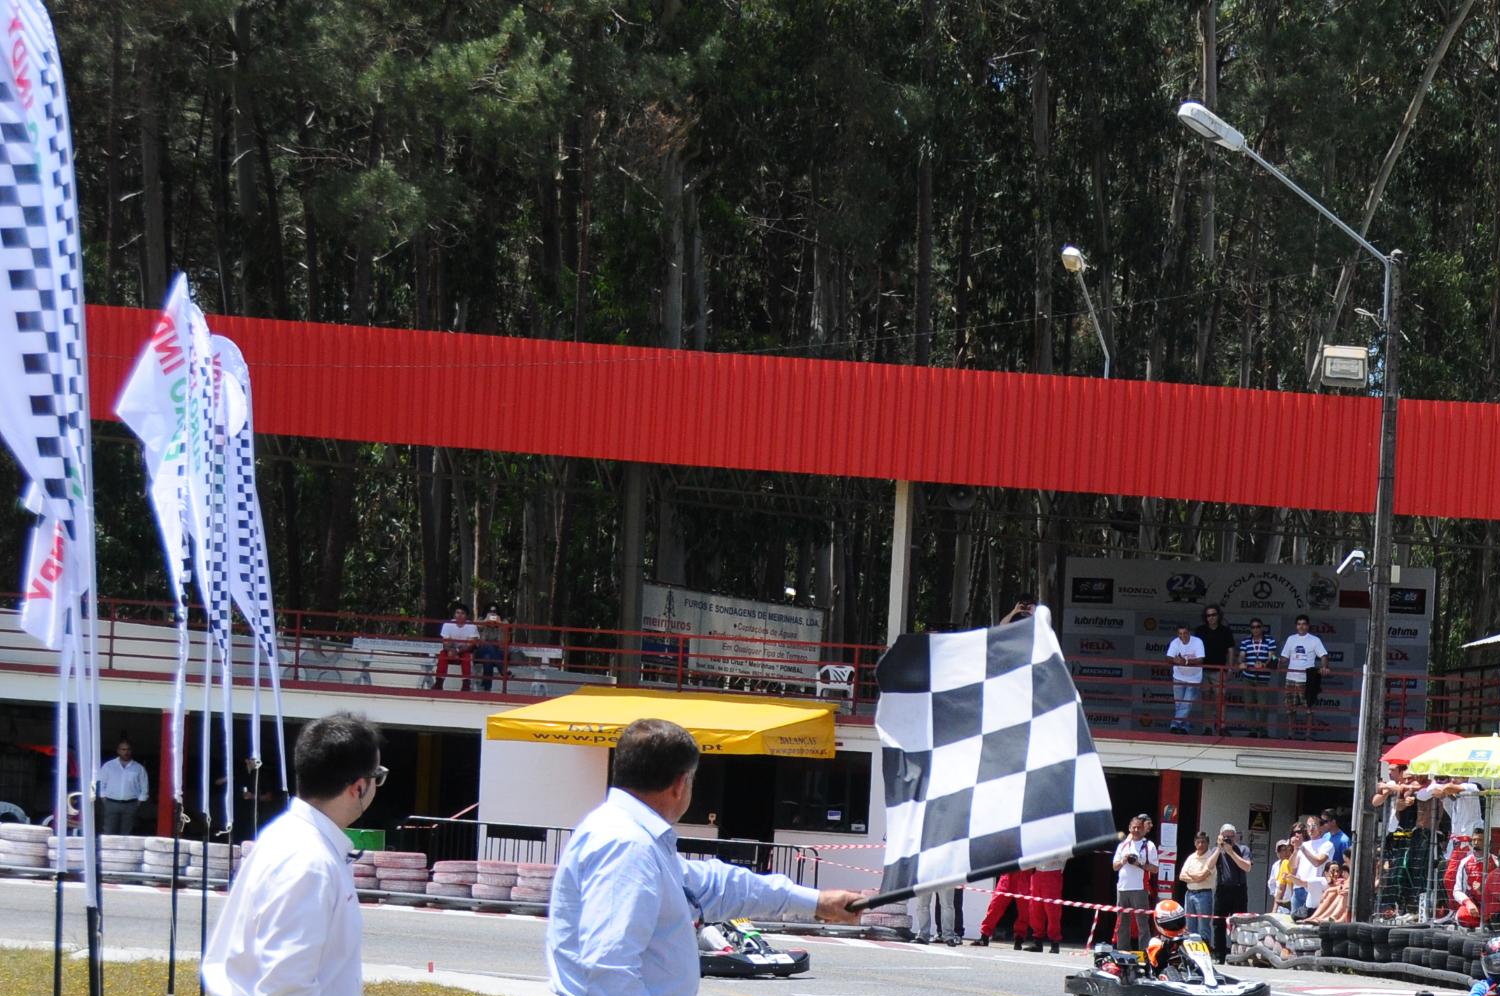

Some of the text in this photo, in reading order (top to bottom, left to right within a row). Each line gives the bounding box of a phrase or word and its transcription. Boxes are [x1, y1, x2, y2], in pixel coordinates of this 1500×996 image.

[1172, 575, 1197, 592] 24
[1118, 586, 1158, 594] HONDA
[684, 598, 708, 611] FUROS
[715, 605, 756, 618] SONDAGENS
[758, 611, 767, 620] DE
[1240, 600, 1286, 609] EUROINDY
[1080, 638, 1116, 650] HELIX
